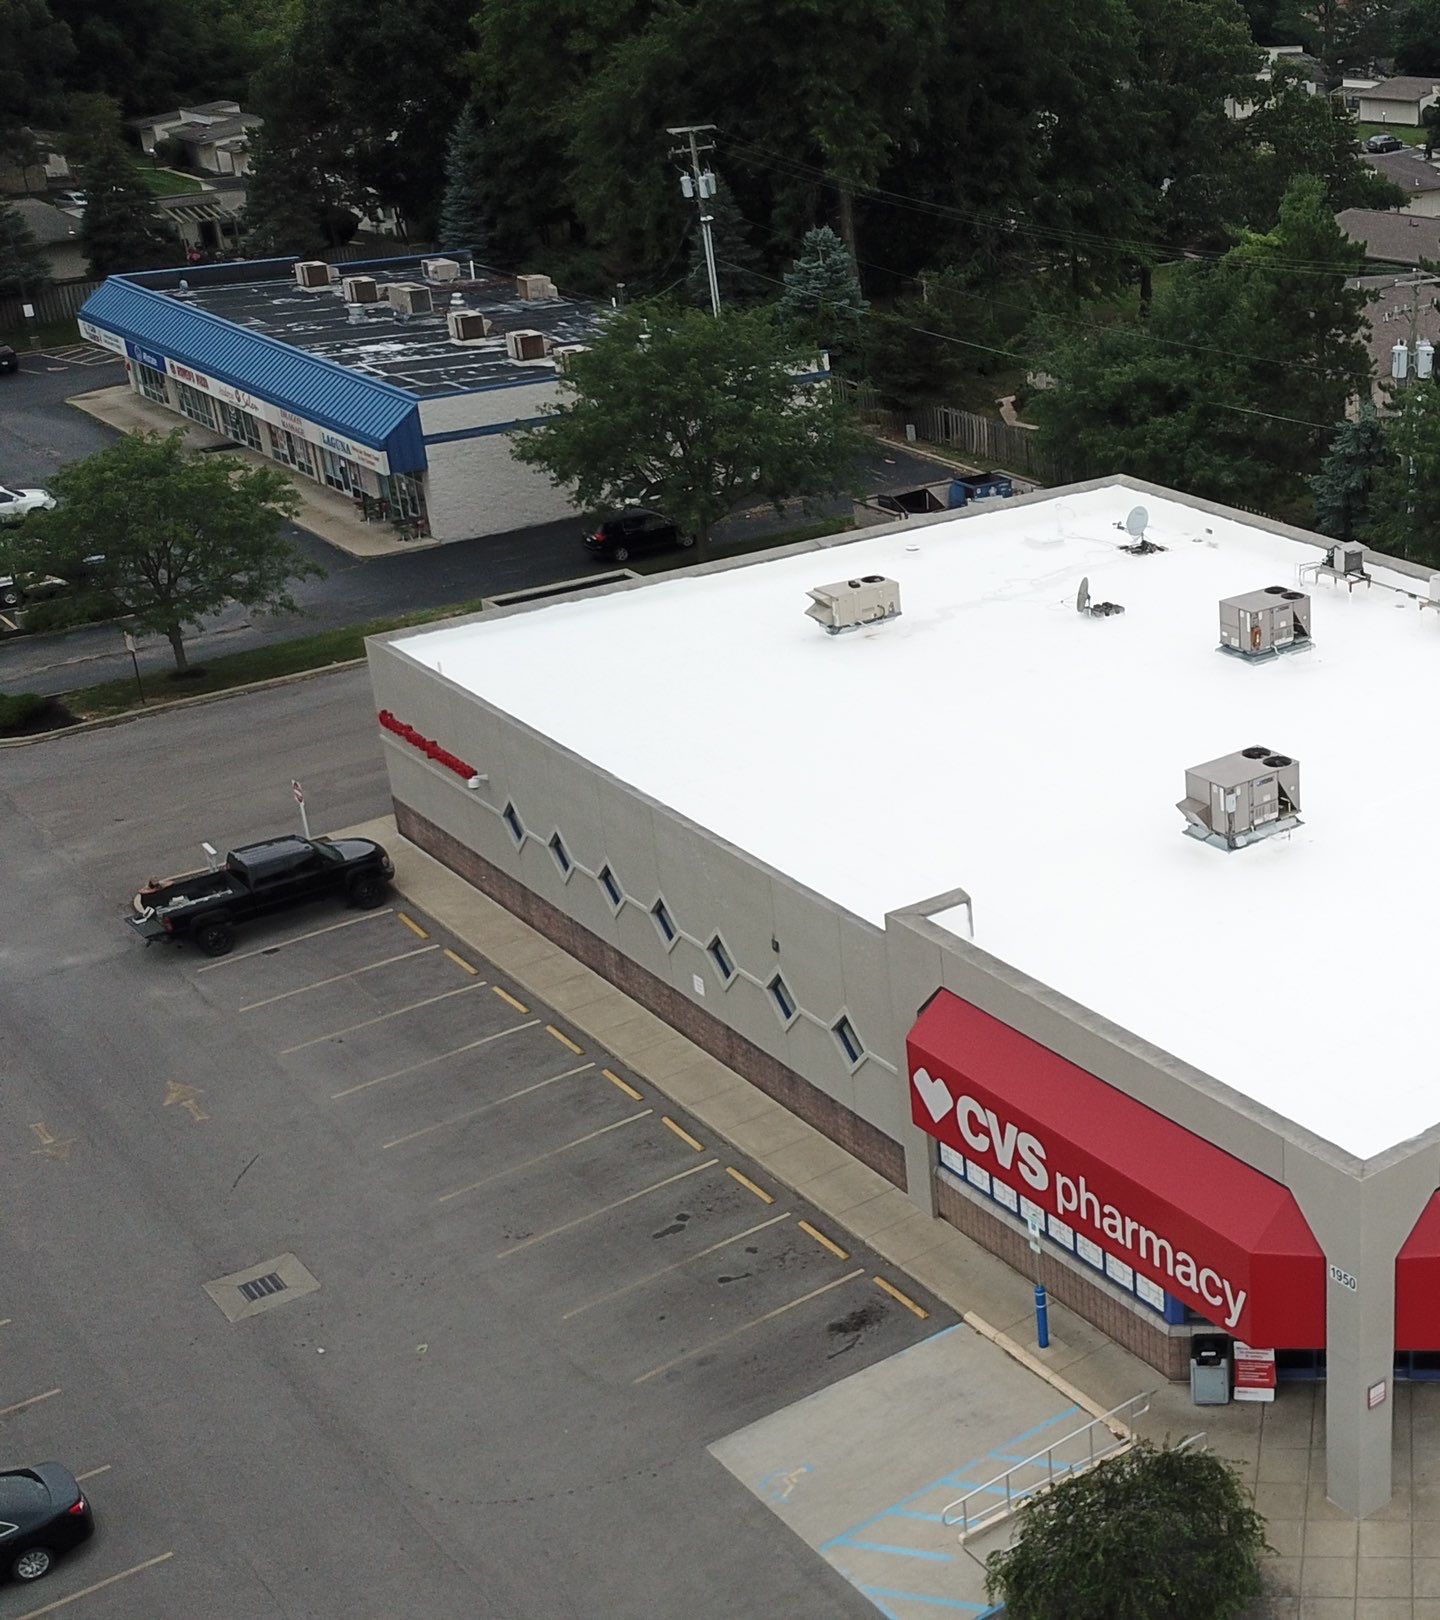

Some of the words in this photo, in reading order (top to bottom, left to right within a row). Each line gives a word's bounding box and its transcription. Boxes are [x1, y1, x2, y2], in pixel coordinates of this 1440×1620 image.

[321, 432, 352, 456] LAGUNA
[956, 1094, 1049, 1192] CVS
[1056, 1172, 1247, 1328] pharmacy
[1331, 1267, 1356, 1290] 1950
